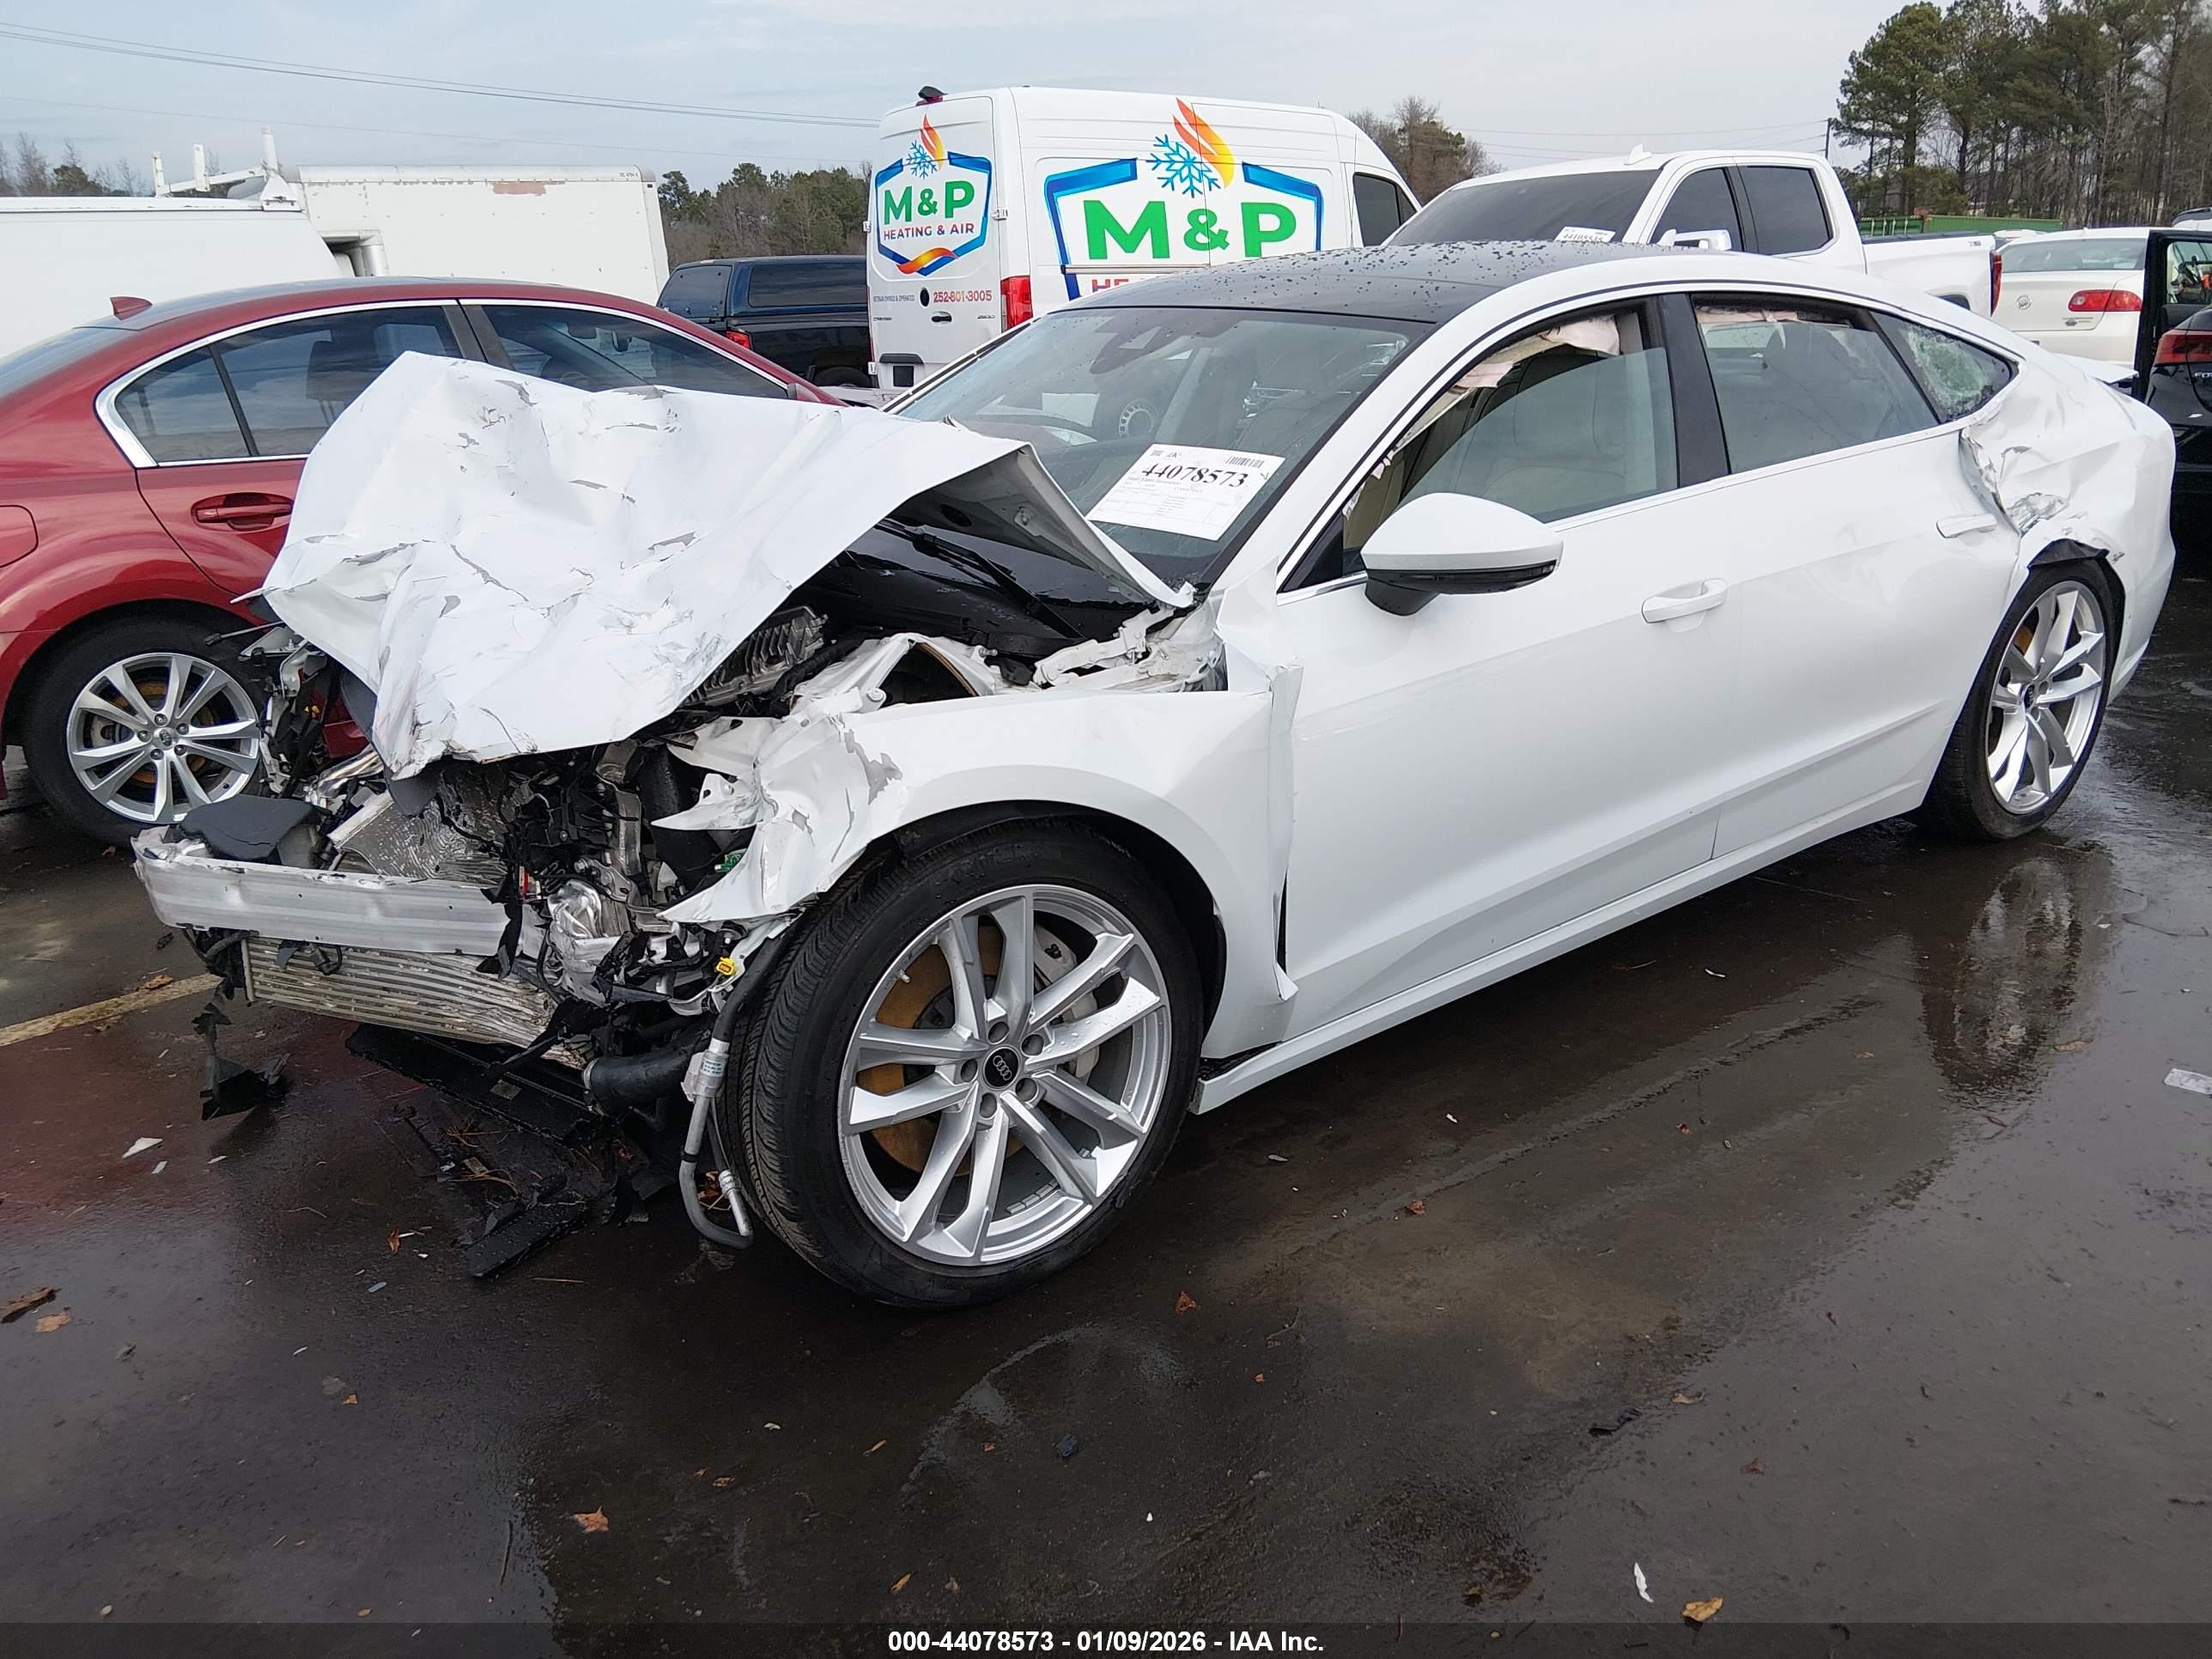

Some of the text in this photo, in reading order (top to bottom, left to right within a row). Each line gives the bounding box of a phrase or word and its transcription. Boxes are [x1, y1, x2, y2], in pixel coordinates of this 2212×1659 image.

[884, 223, 975, 240] HEATING & AIR
[933, 290, 993, 303] 252-801-3005
[1142, 463, 1249, 488] 44078573
